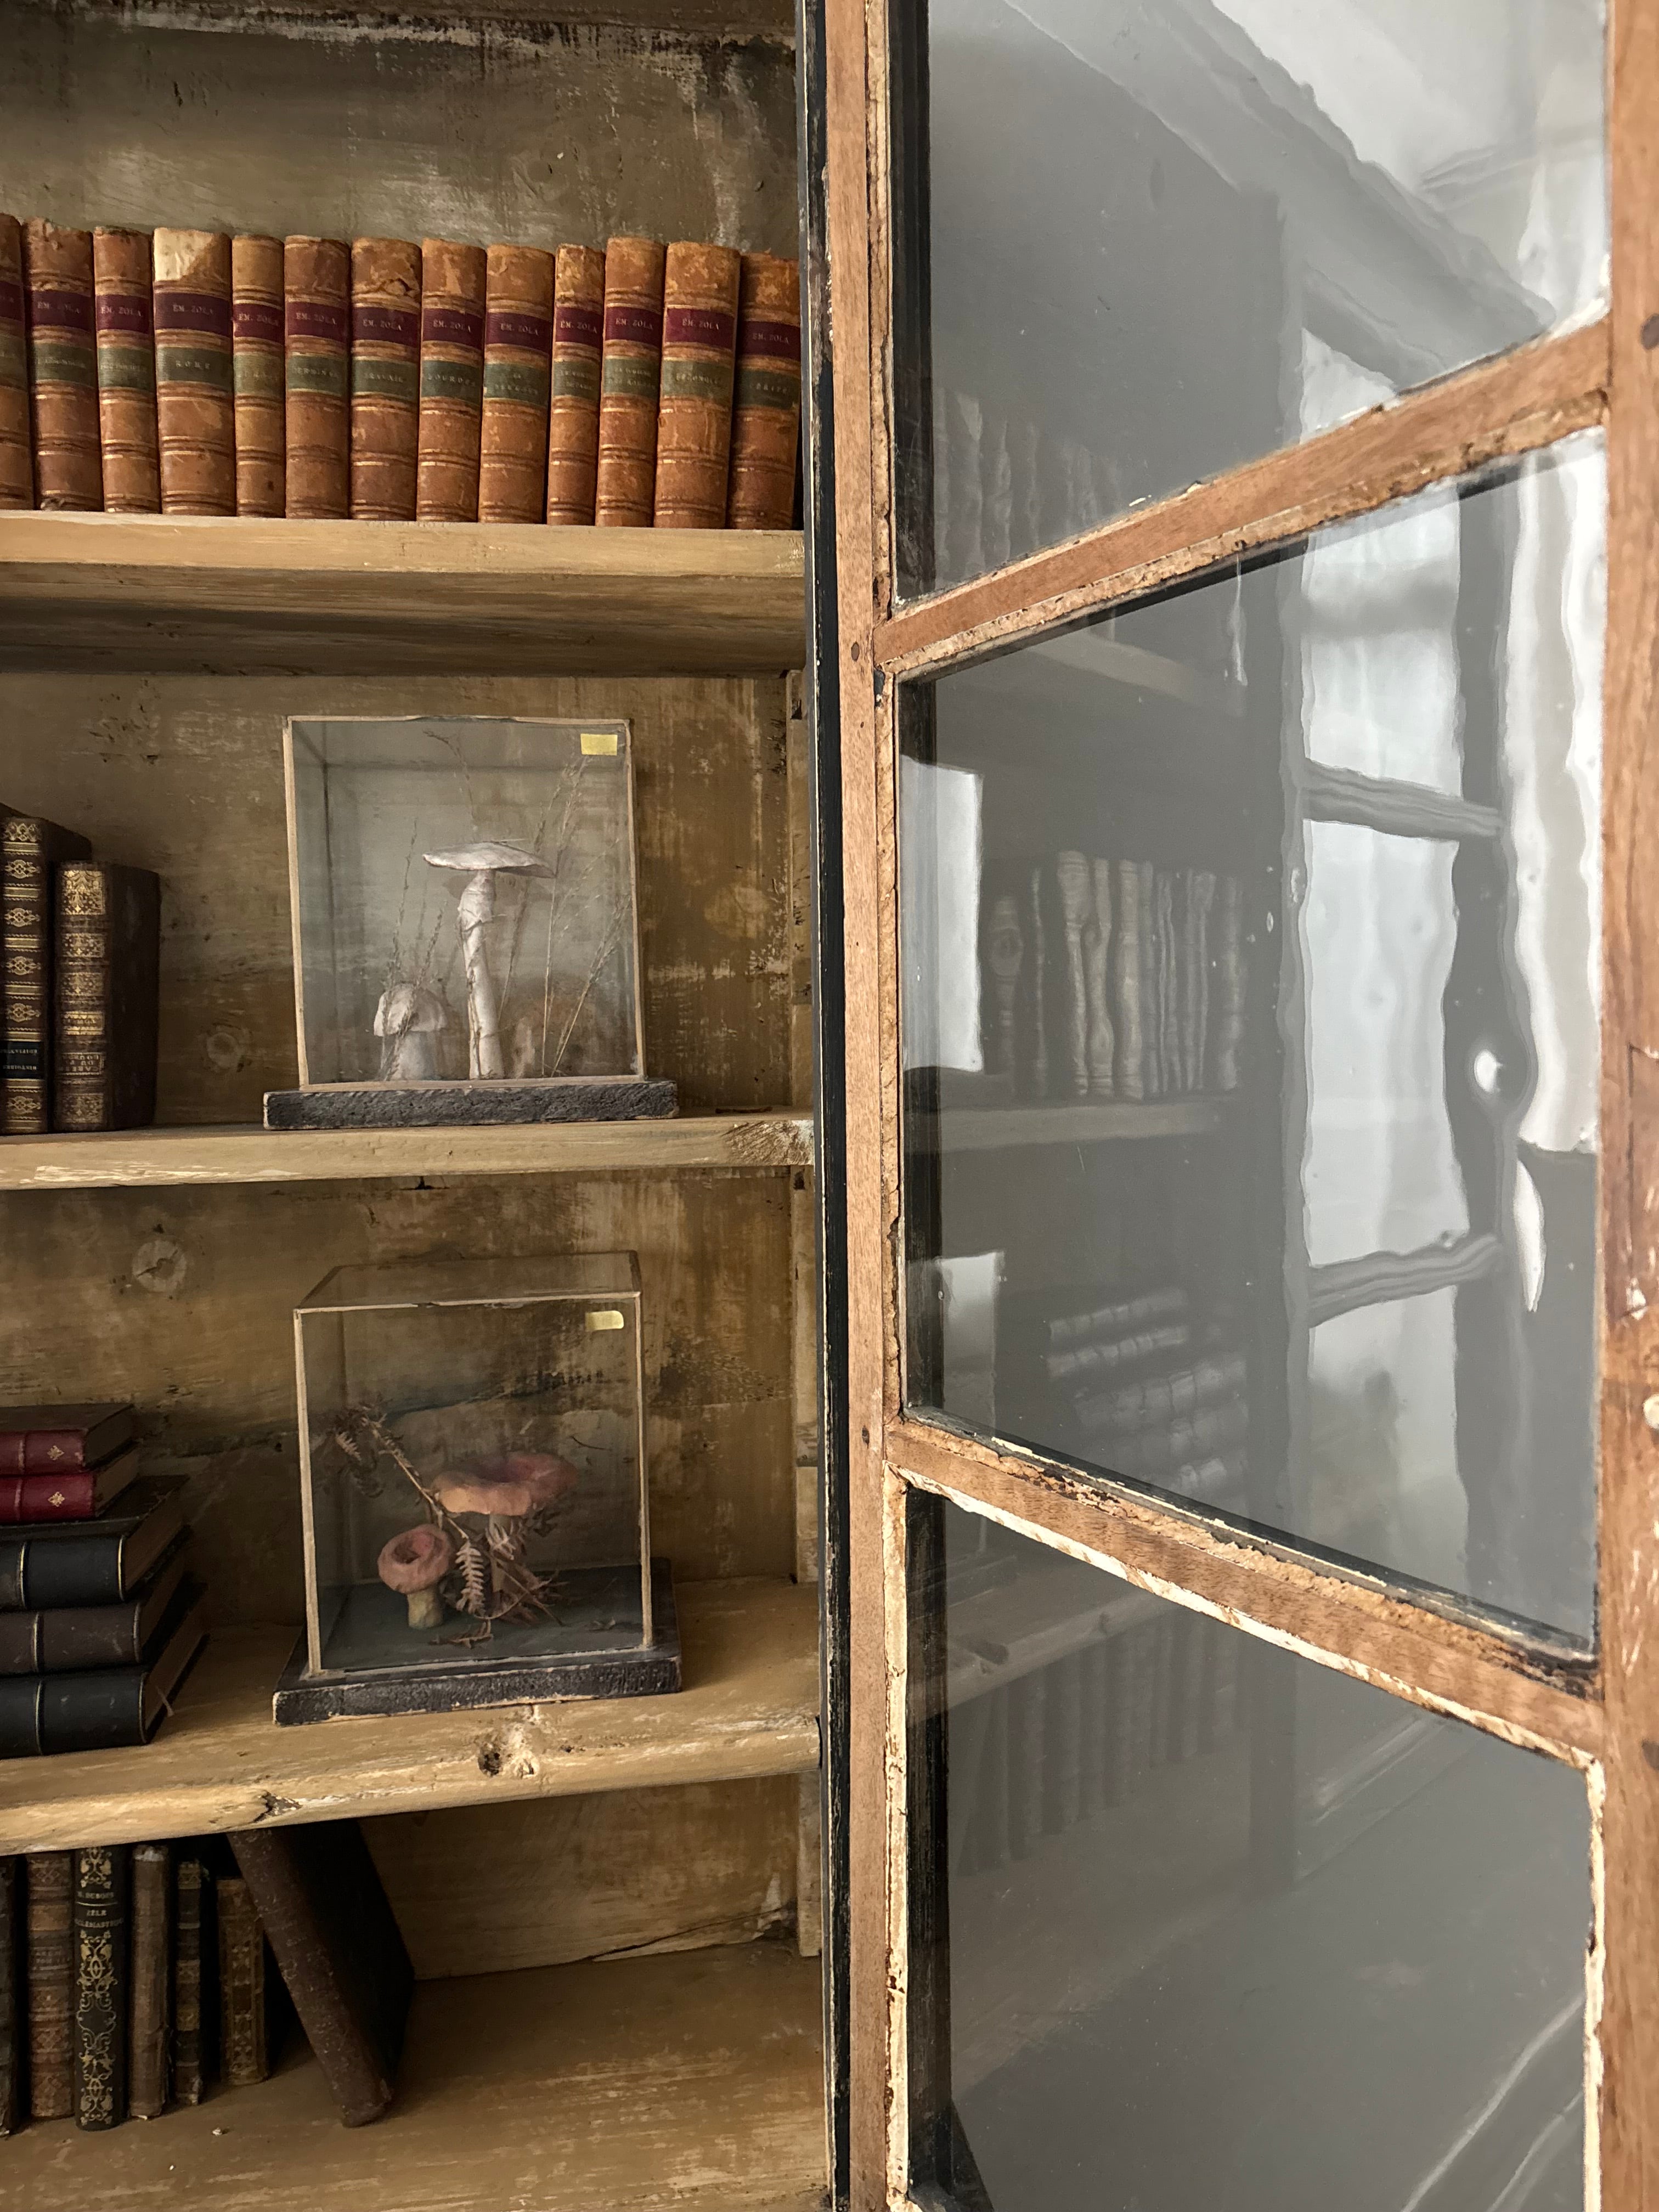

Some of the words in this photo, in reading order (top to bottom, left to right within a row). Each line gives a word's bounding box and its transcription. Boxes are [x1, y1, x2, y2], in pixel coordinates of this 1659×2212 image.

[239, 313, 253, 321] EM.
[295, 312, 311, 320] EM.
[363, 319, 377, 328] EM.
[432, 319, 447, 328] EM.
[560, 319, 574, 329] EM.
[577, 321, 597, 334] ZOLA
[632, 319, 653, 331] ZOLA
[752, 332, 766, 341] EM.
